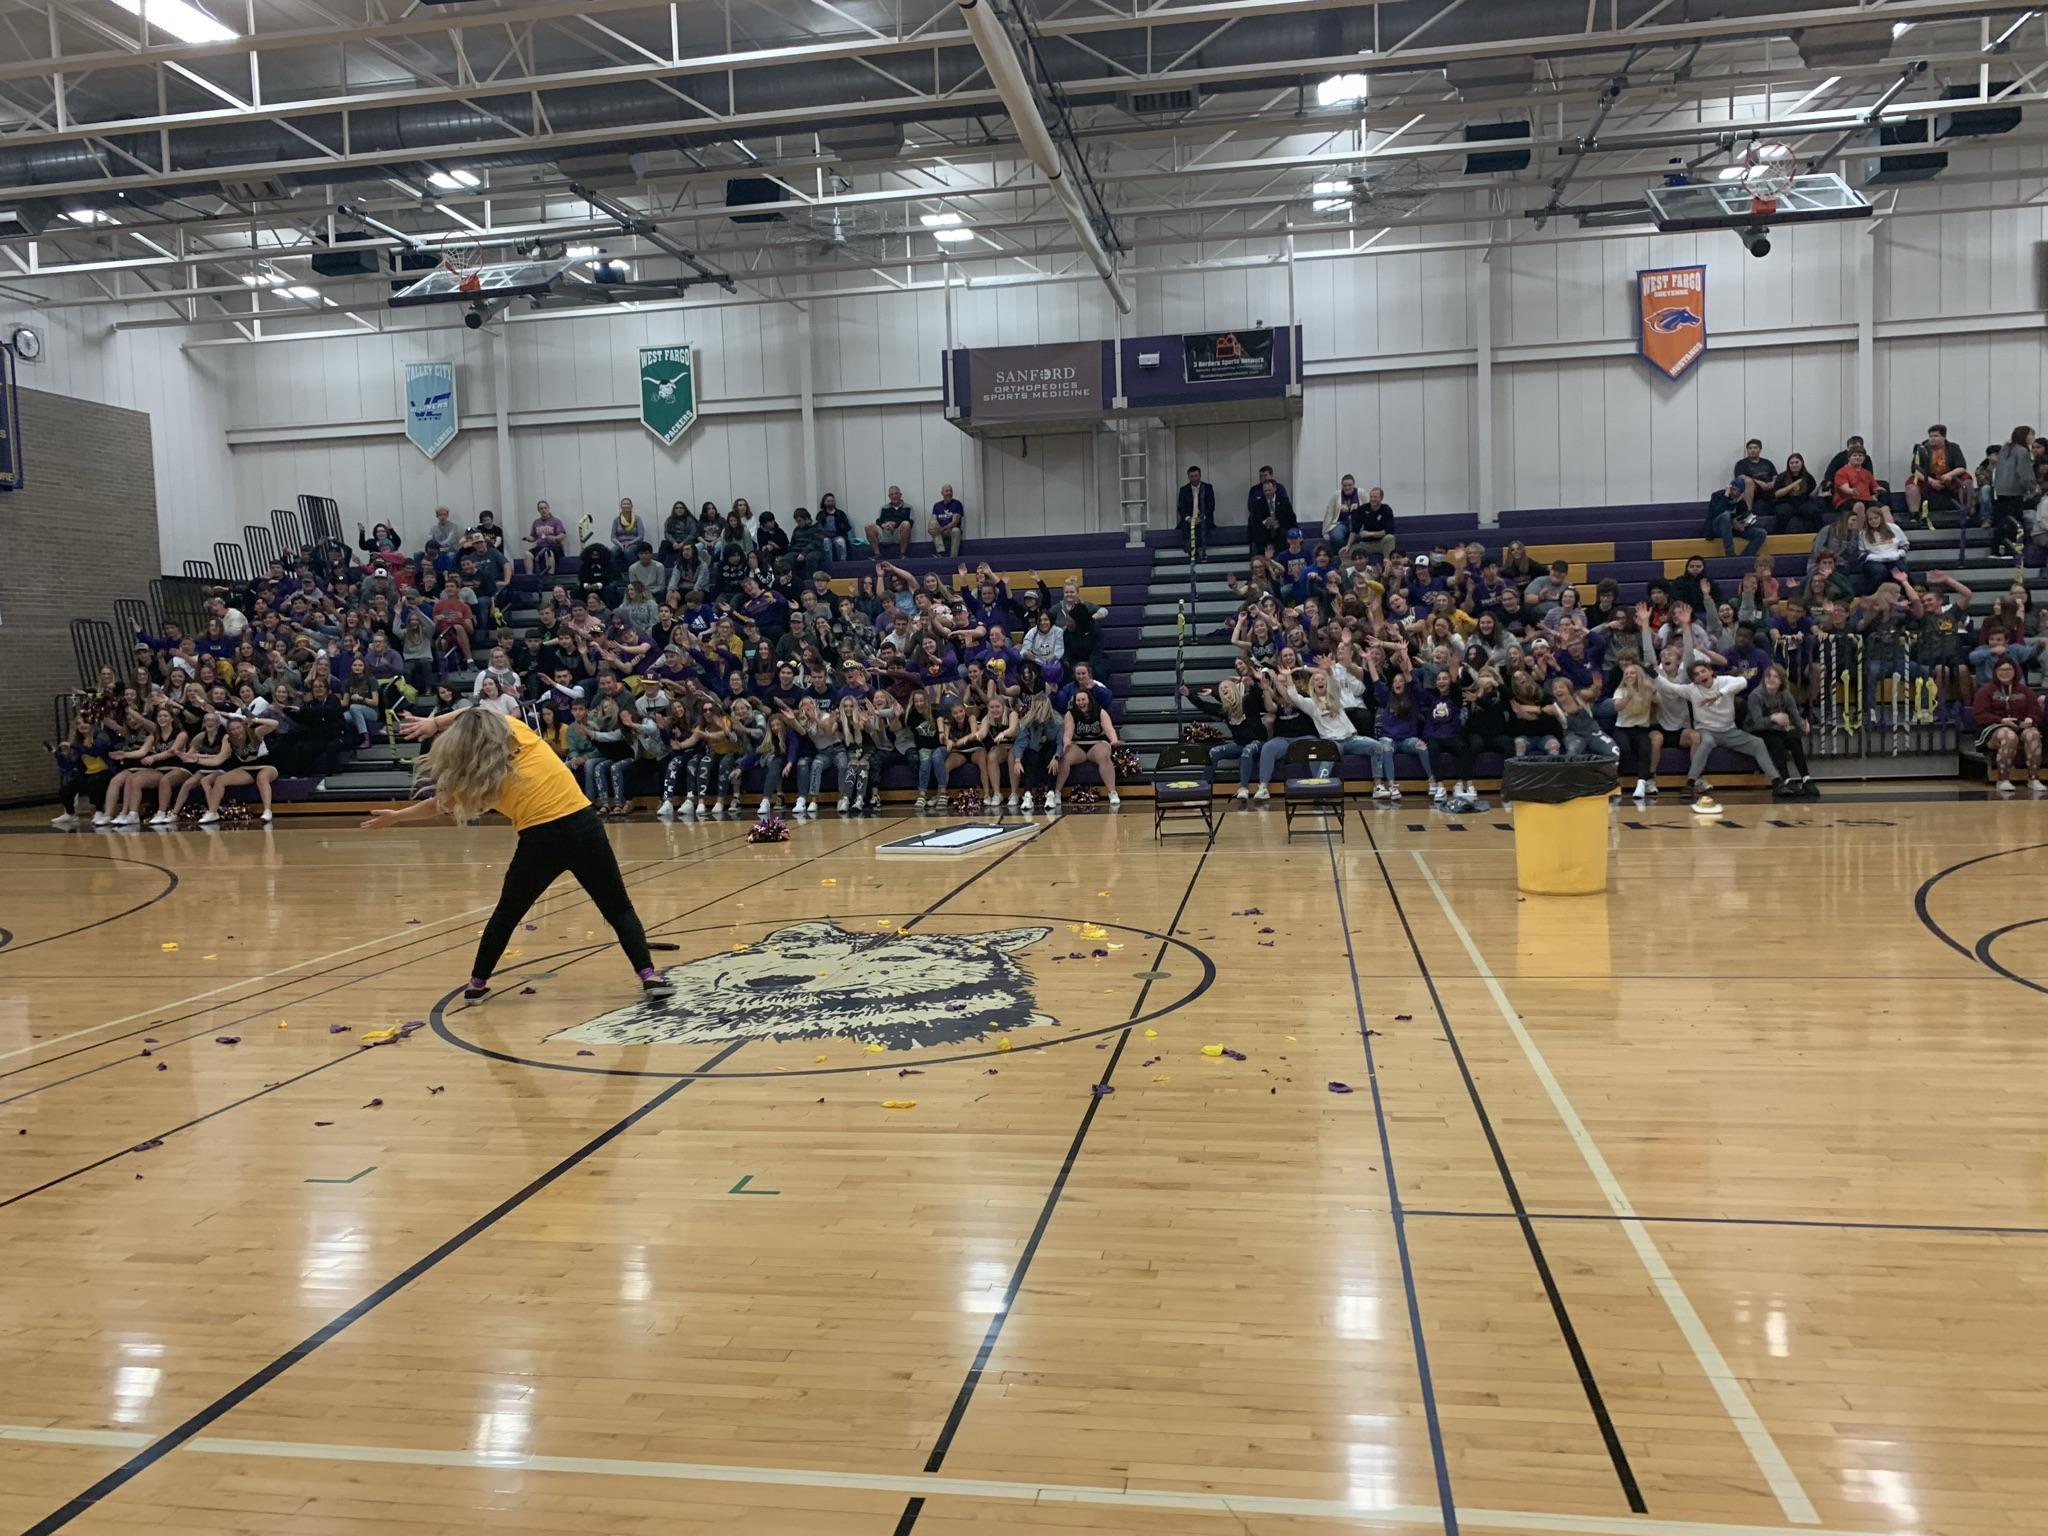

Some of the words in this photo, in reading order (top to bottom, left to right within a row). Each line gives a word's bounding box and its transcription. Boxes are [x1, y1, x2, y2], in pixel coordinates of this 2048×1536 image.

[1642, 274, 1668, 296] WEST
[1671, 272, 1701, 292] FARGO
[640, 350, 662, 369] WEST
[664, 348, 690, 366] FARGO
[1669, 342, 1703, 377] MUSTANGS
[406, 365, 433, 382] VALLEY
[434, 364, 452, 380] CITY
[996, 367, 1076, 383] SANFORD
[983, 392, 1028, 402] SPORTS
[1032, 388, 1091, 398] MEDICINE
[994, 382, 1078, 393] ORTHOPEDICS
[664, 409, 693, 441] PACKERS
